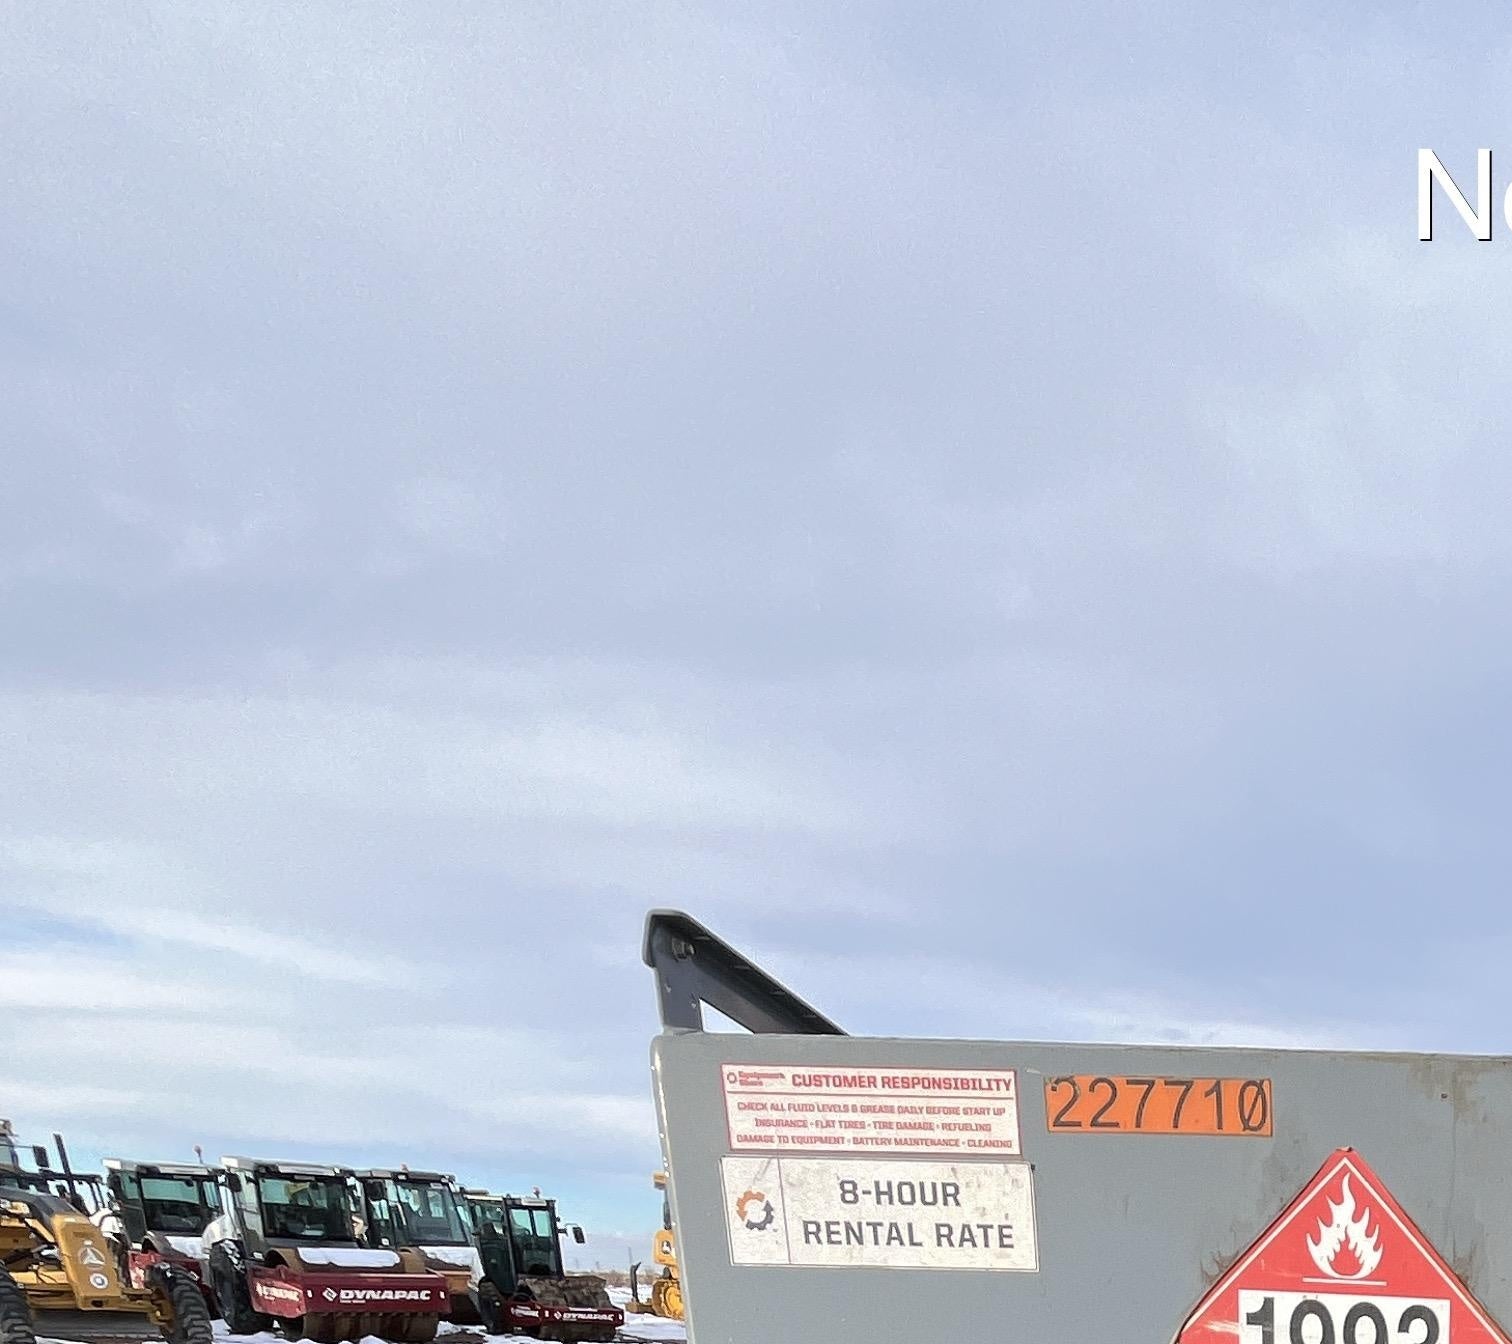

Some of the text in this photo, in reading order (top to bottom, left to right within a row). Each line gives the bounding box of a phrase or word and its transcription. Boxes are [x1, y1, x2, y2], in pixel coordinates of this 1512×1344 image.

[791, 1073, 1012, 1091] CUSTOMER RESPONSIBILITY
[737, 1101, 769, 1112] CHECK
[770, 1102, 786, 1112] ALL
[962, 1107, 991, 1116] START
[993, 1107, 1006, 1116] UP
[1050, 1075, 1268, 1132] 227710
[777, 1134, 789, 1144] TO
[791, 1135, 845, 1145] EQUIPMENT
[967, 1139, 1012, 1149] CLEANING
[839, 1179, 961, 1208] 8-HOUR
[802, 1220, 1014, 1250] RENTAL RATE
[340, 1289, 432, 1300] DYNAPAC
